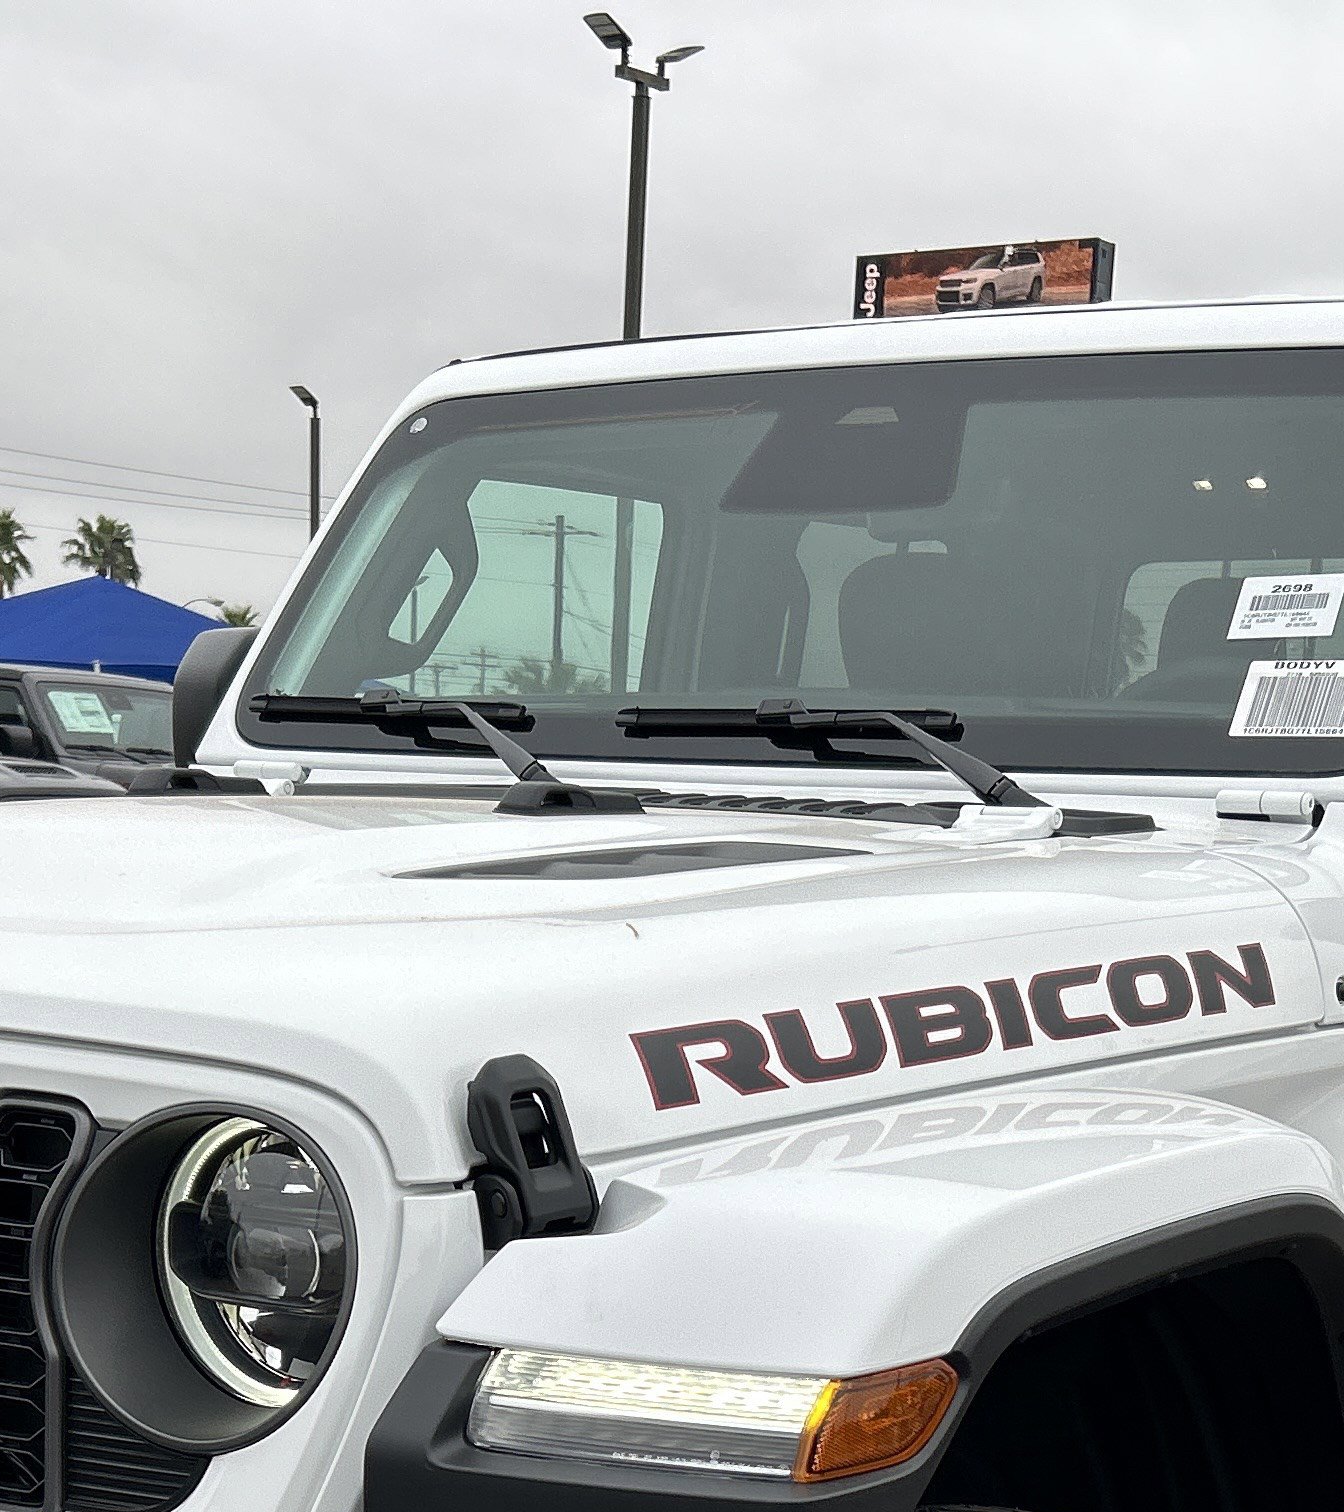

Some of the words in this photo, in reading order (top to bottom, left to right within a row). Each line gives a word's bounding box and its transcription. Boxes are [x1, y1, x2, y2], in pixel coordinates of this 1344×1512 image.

[859, 263, 881, 317] Jeep
[1271, 583, 1314, 594] 2698
[629, 942, 1276, 1112] RUBICON
